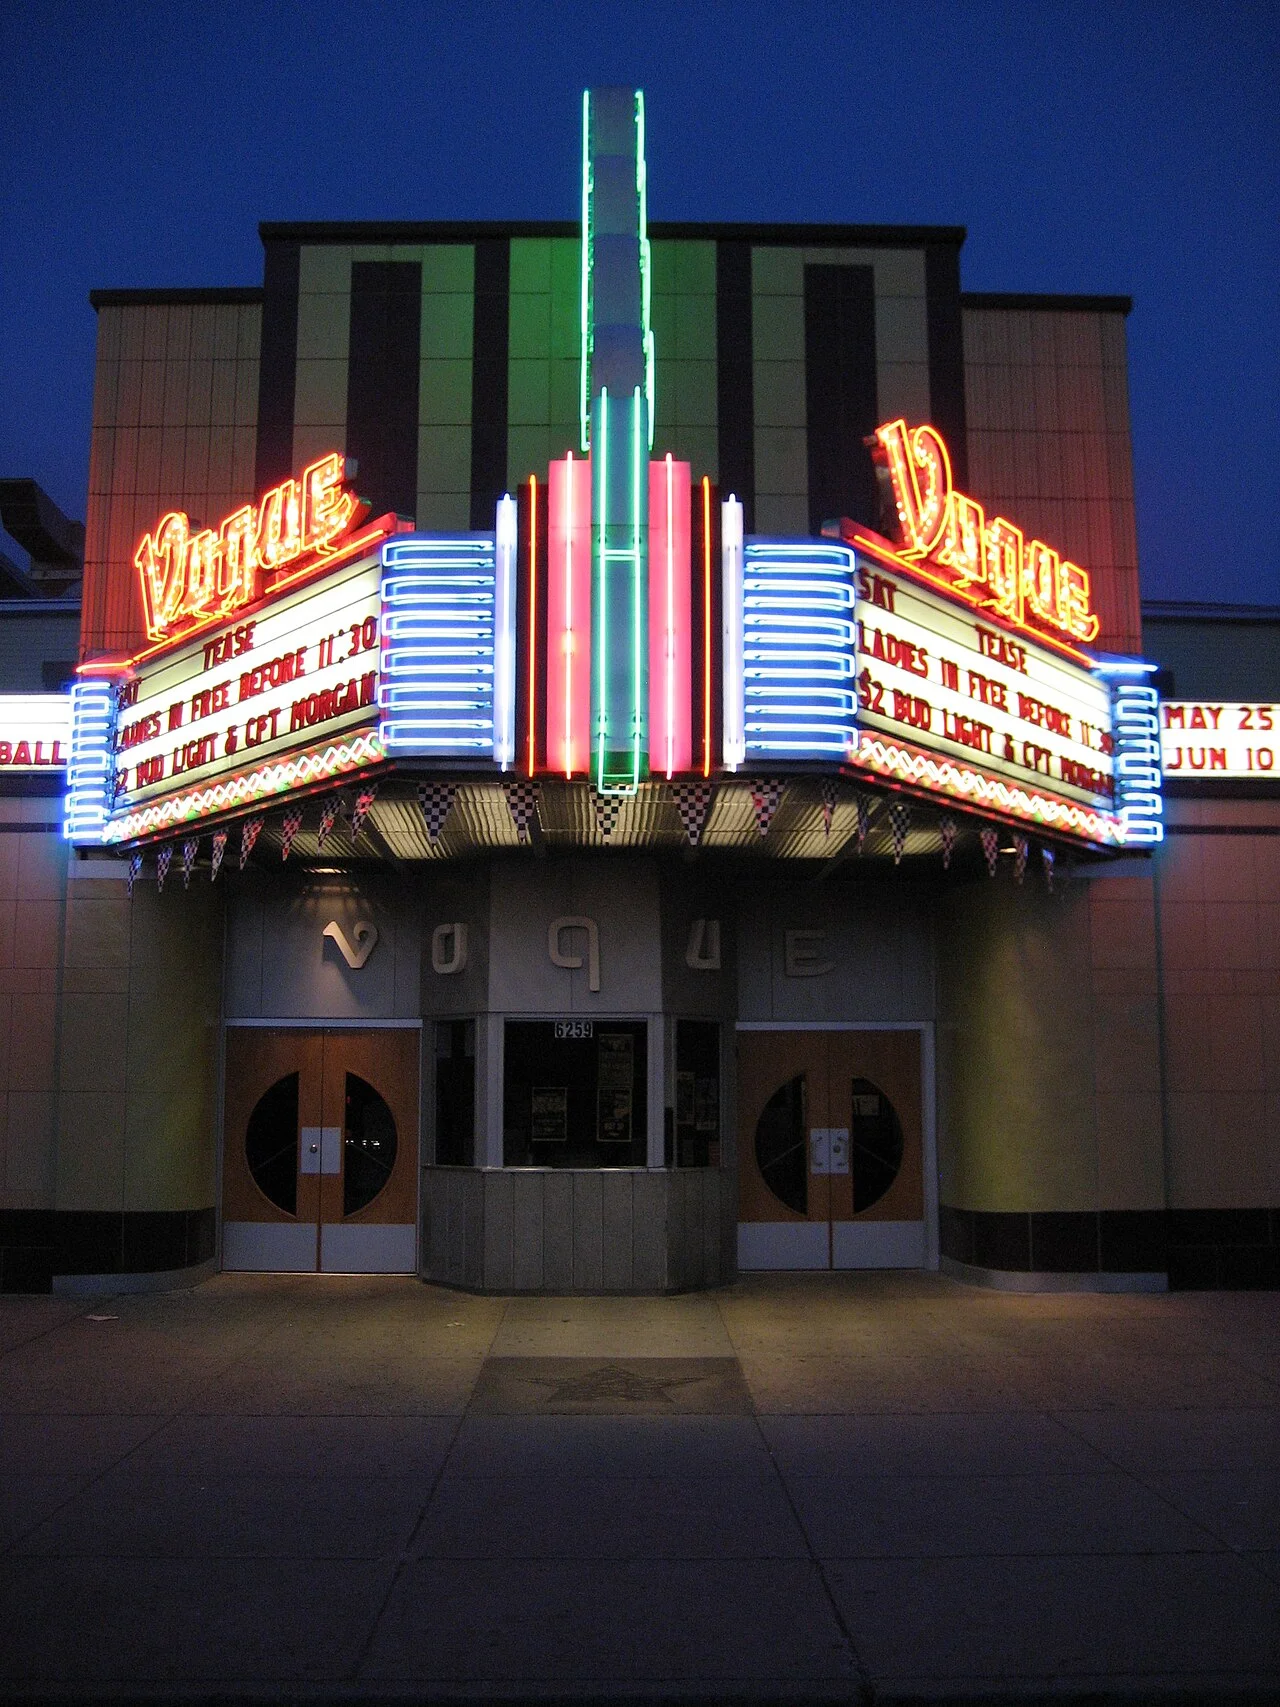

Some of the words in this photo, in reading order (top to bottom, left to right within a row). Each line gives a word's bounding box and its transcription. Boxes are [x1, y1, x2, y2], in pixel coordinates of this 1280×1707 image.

[202, 621, 257, 671] TEASE
[858, 568, 897, 613] SAT
[974, 623, 1027, 677] TEASE
[113, 711, 162, 754] LADIES
[168, 701, 184, 733] IN
[191, 680, 231, 722] FREE
[238, 646, 307, 702] BEFORE
[318, 616, 378, 670] 11:30
[858, 619, 929, 679] LADIES
[939, 657, 958, 692] IN
[968, 669, 1009, 714] FREE
[1017, 691, 1073, 740] BEFORE
[1163, 706, 1223, 730] MAY
[1238, 706, 1274, 731] 25
[0, 740, 67, 765] BALL
[136, 754, 165, 790] BUD
[172, 732, 219, 776] LIGHT
[224, 725, 238, 756] &
[246, 707, 281, 748] CPT
[290, 670, 378, 733] MORGAN
[857, 667, 886, 716] $2
[893, 688, 932, 733] BUD
[942, 708, 994, 754] LIGHT
[1003, 732, 1015, 762] &
[1023, 740, 1053, 776] CPT
[1166, 747, 1227, 770] JUN
[1246, 747, 1274, 771] 10
[555, 1022, 593, 1038] 6259
